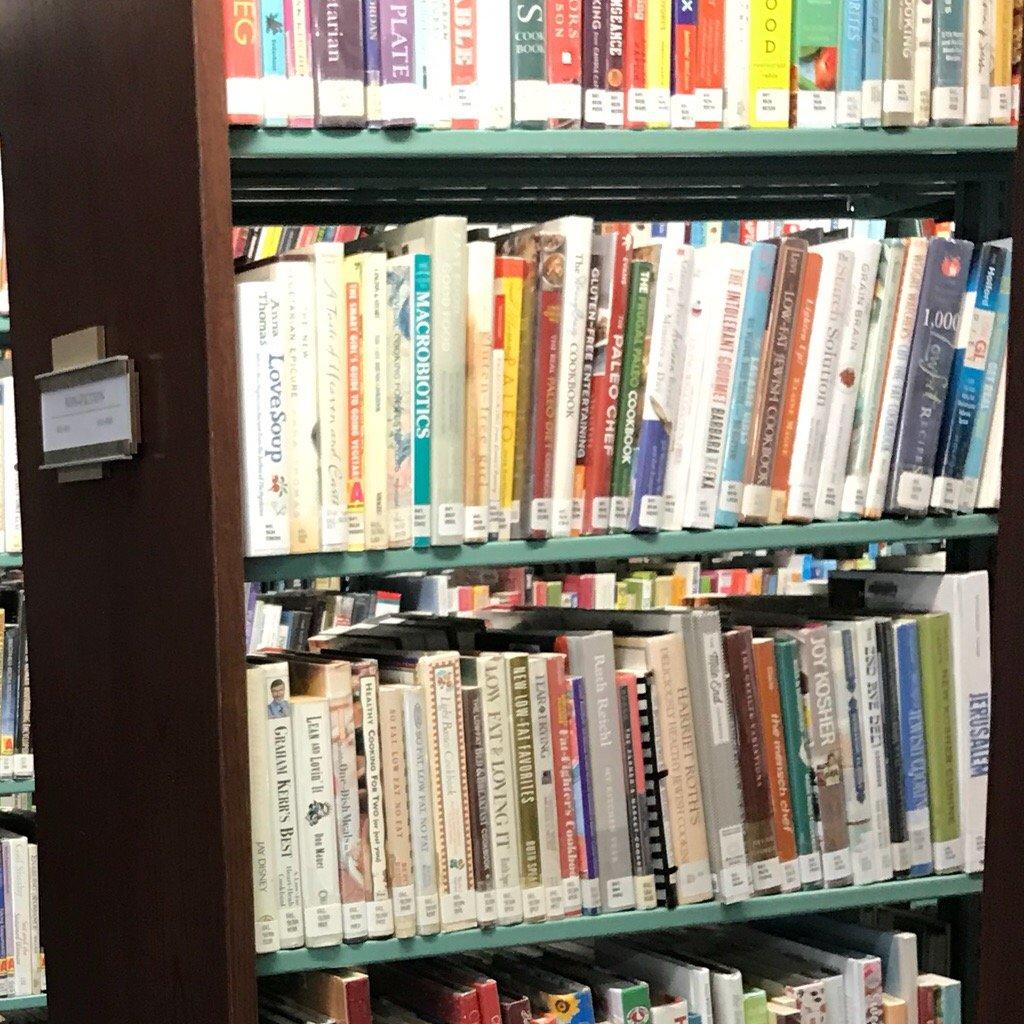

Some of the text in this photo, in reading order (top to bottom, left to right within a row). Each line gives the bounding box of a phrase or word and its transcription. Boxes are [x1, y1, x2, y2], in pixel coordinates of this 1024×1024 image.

[390, 5, 409, 78] PLATE
[620, 257, 629, 285] EVANS
[638, 271, 650, 293] THE
[257, 292, 269, 346] Thomas
[719, 290, 742, 353] INTOLERANT
[849, 263, 871, 351] GRAIN BRAIN
[414, 291, 431, 439] MACROBIOTICS
[565, 342, 579, 419] COOKBOOK
[576, 267, 600, 458] GLUTEN-FREE ENTERTAINING
[608, 334, 624, 400] PALEO
[768, 353, 787, 401] JEWISH
[816, 326, 840, 407] Solution
[602, 405, 617, 457] CHEF
[621, 390, 638, 464] COOKBOOK
[705, 408, 725, 454] BARBARA
[756, 407, 779, 485] COOKBOOK
[484, 666, 500, 706] LOW
[513, 666, 528, 690] NEW
[594, 654, 608, 693] Ruth
[809, 636, 836, 746] JOY KOSHER
[365, 683, 375, 725] HEALTHY
[487, 712, 503, 741] FAT
[771, 713, 781, 736] the
[367, 729, 377, 771] COOKING
[968, 692, 989, 778] JERUSALEM
[274, 726, 295, 860] GRAHAM KERR'S BEST
[490, 760, 508, 827] LOVING
[518, 744, 535, 804] FAVORITES
[372, 796, 380, 817] TWO
[495, 832, 511, 850] IT
[258, 858, 268, 892] DISNEY
